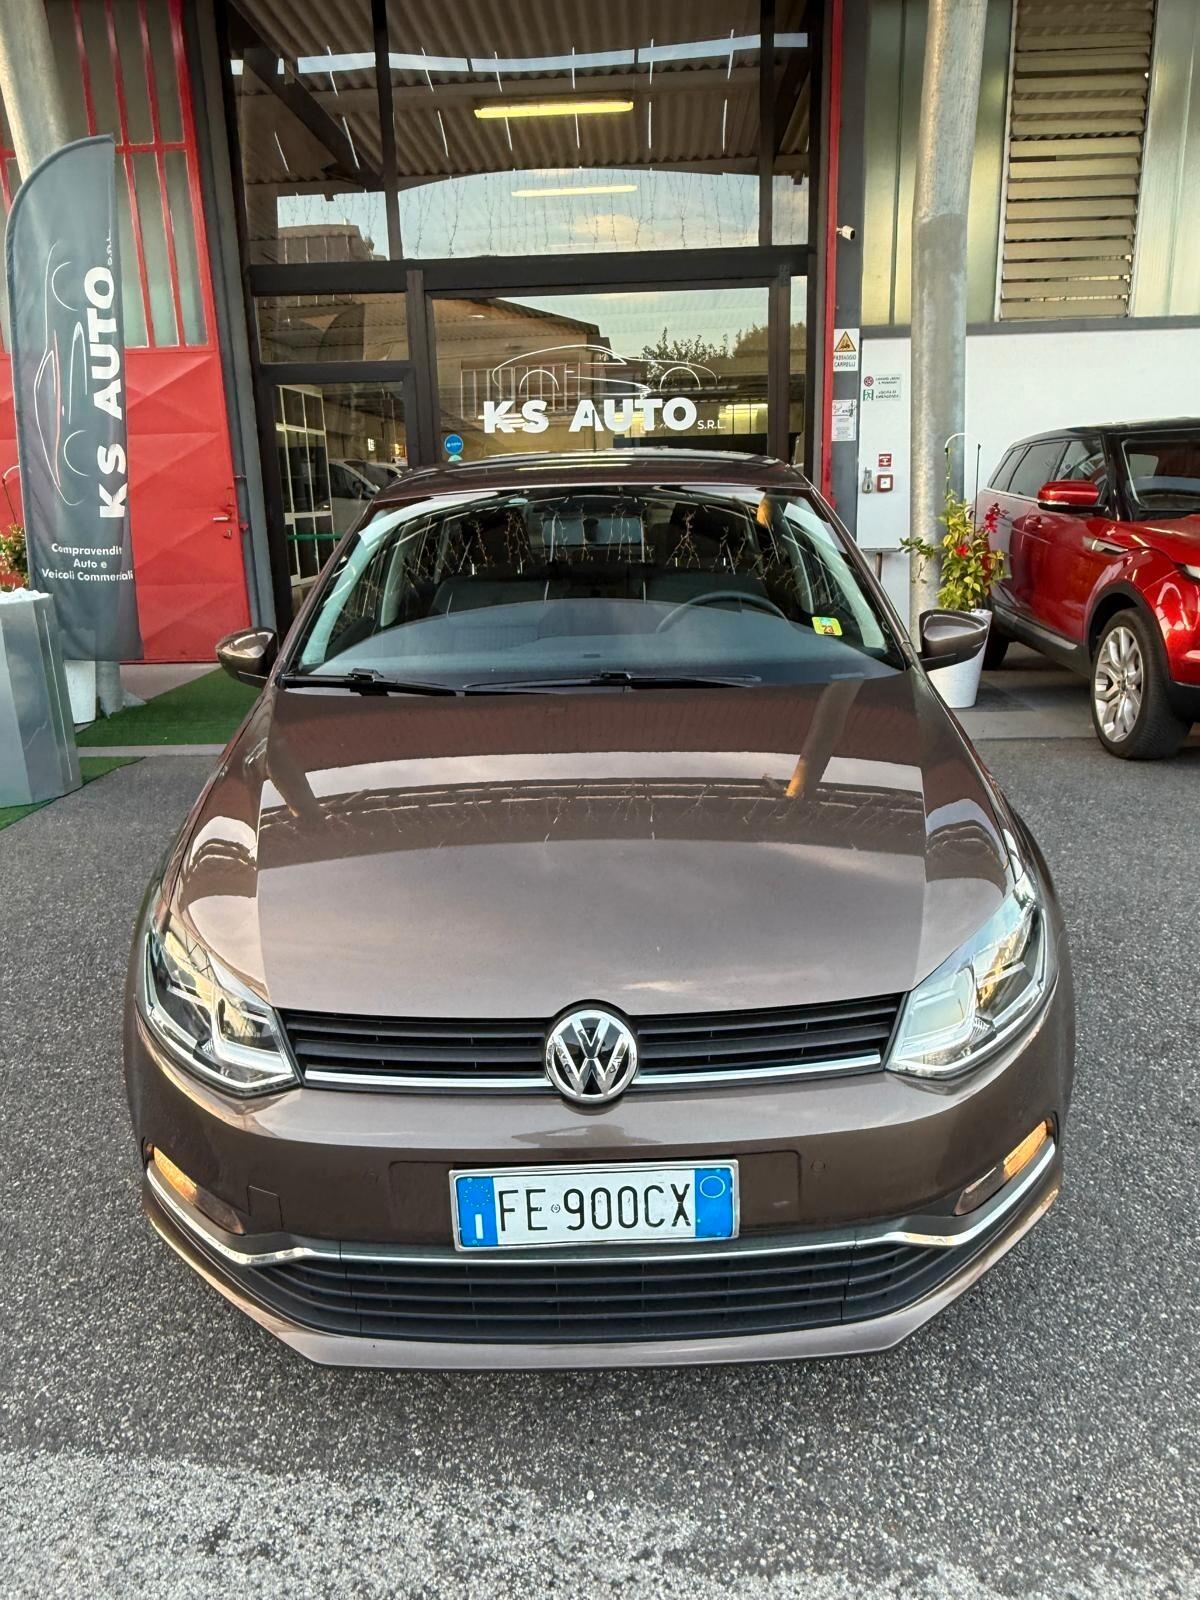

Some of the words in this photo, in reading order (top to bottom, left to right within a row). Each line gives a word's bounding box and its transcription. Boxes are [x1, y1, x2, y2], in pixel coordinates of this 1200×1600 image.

[84, 266, 123, 420] AUTO
[483, 400, 549, 434] KS
[569, 397, 698, 433] AUTO
[97, 444, 127, 518] KS
[51, 543, 122, 557] Compravendit
[41, 568, 75, 580] Veicoli
[77, 570, 134, 582] Commeriali
[73, 558, 98, 568] Auto
[100, 561, 108, 569] e
